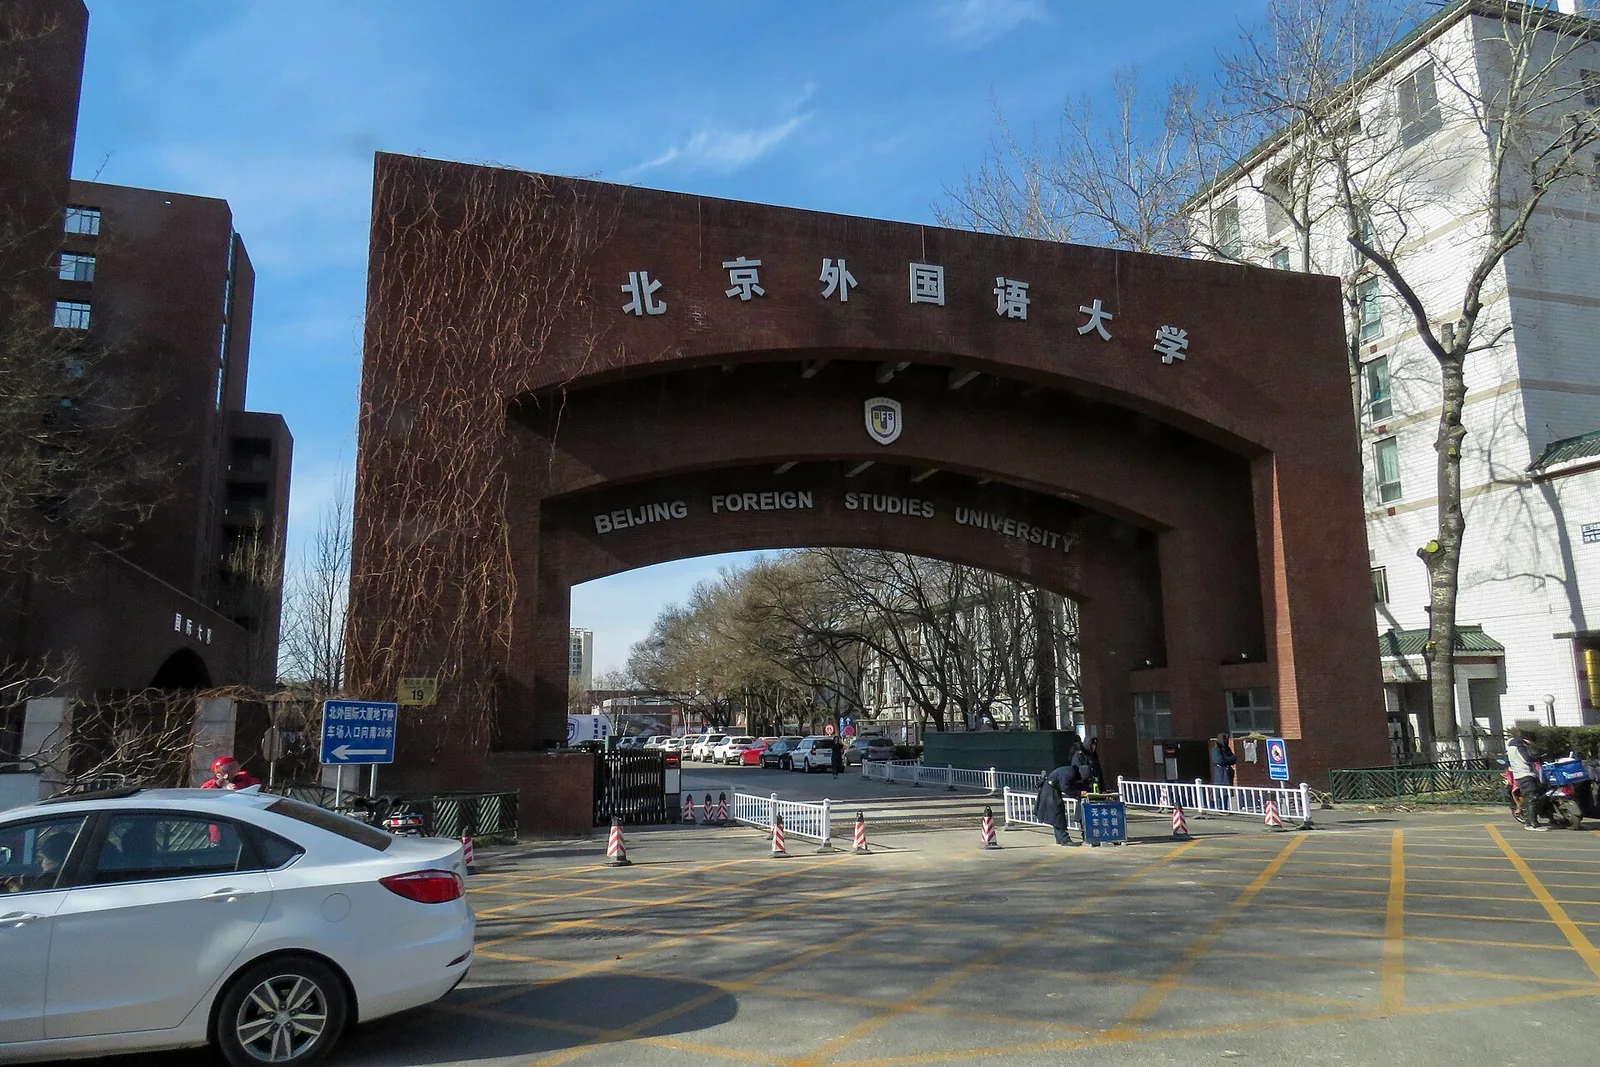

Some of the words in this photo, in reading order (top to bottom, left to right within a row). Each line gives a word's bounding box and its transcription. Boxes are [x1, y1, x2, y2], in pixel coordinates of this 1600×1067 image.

[620, 255, 1190, 365] 北京外国语大学
[593, 500, 688, 534] BEIJING
[711, 491, 814, 514] FOREIGN
[844, 492, 935, 518] STUDIES
[954, 506, 1075, 553] UNIVERSITY
[411, 689, 424, 701] 19
[328, 705, 395, 721] 北外国际大厦地下停
[326, 725, 393, 739] 车场入口向南20米
